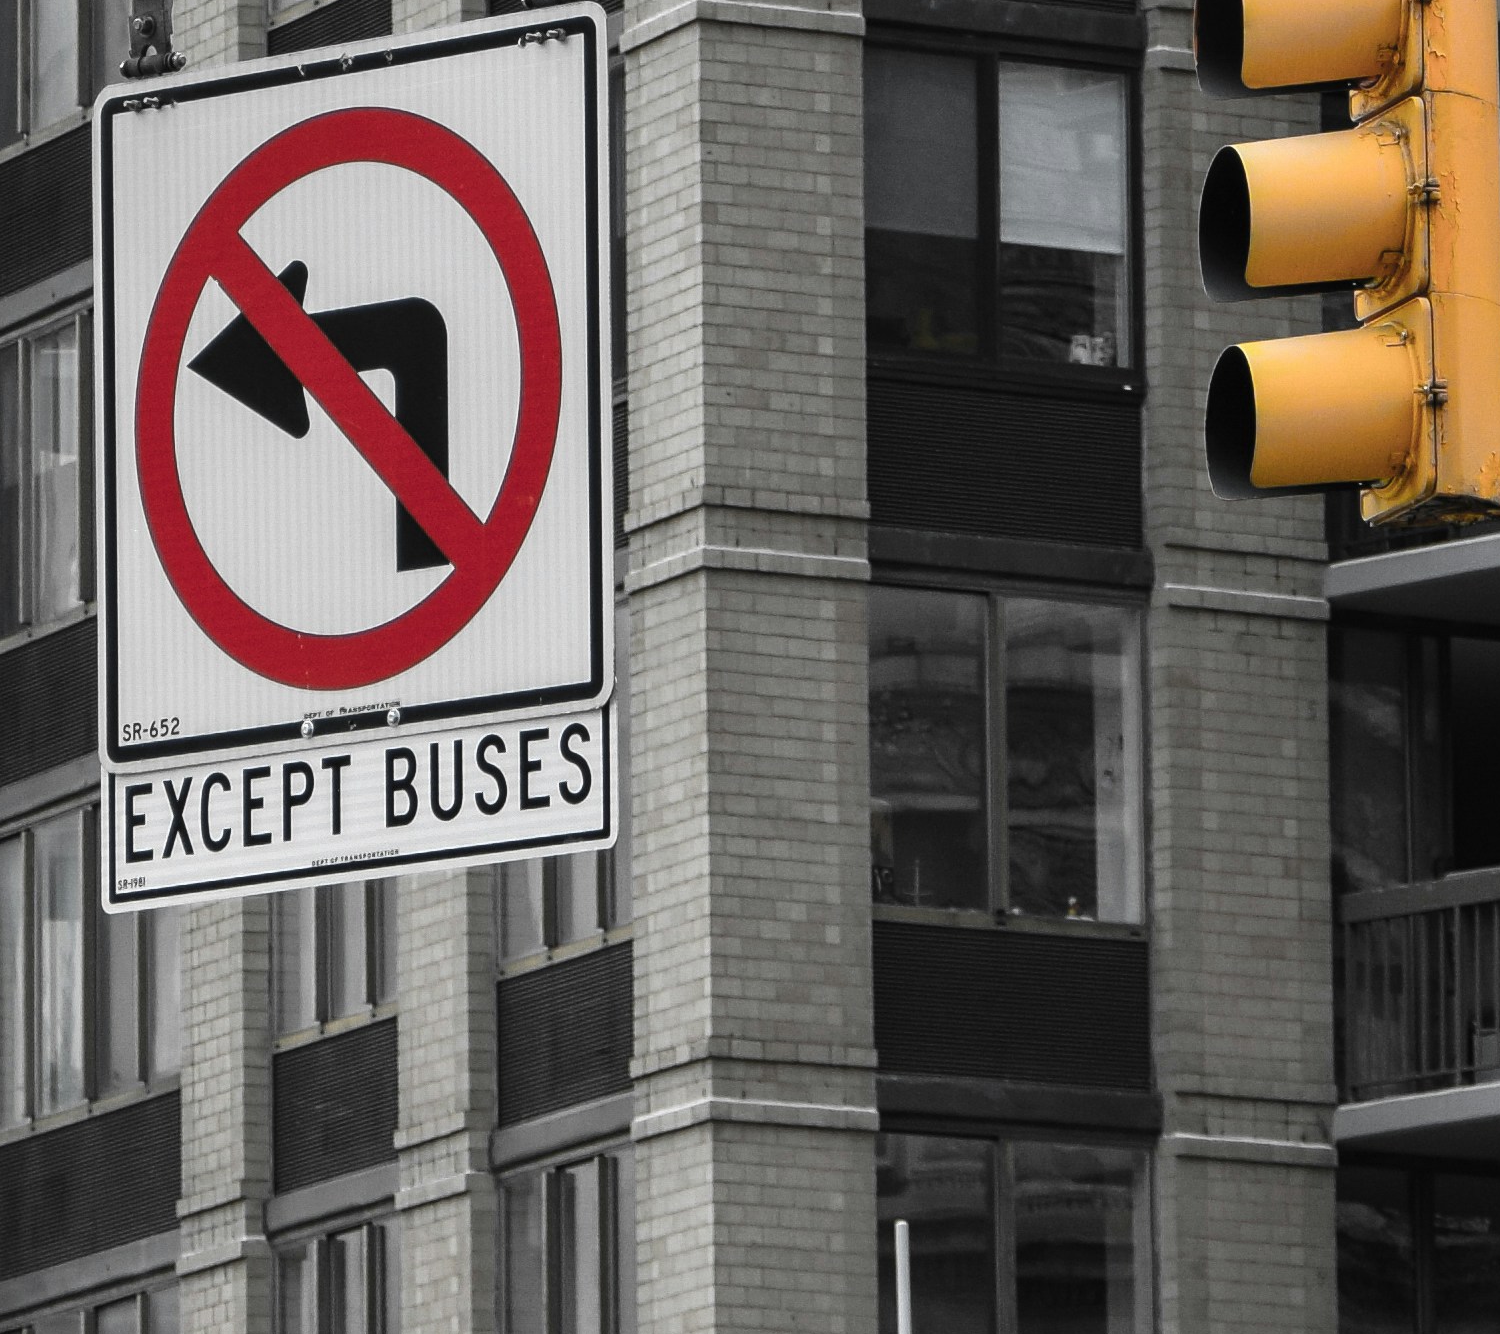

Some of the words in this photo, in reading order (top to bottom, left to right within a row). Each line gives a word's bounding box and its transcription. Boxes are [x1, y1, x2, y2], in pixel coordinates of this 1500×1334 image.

[122, 717, 180, 742] SR-652
[125, 754, 352, 864] EXCEPT
[385, 722, 592, 828] BUSES
[311, 858, 328, 867] DEPT
[340, 849, 399, 862] TRANSPORTATION
